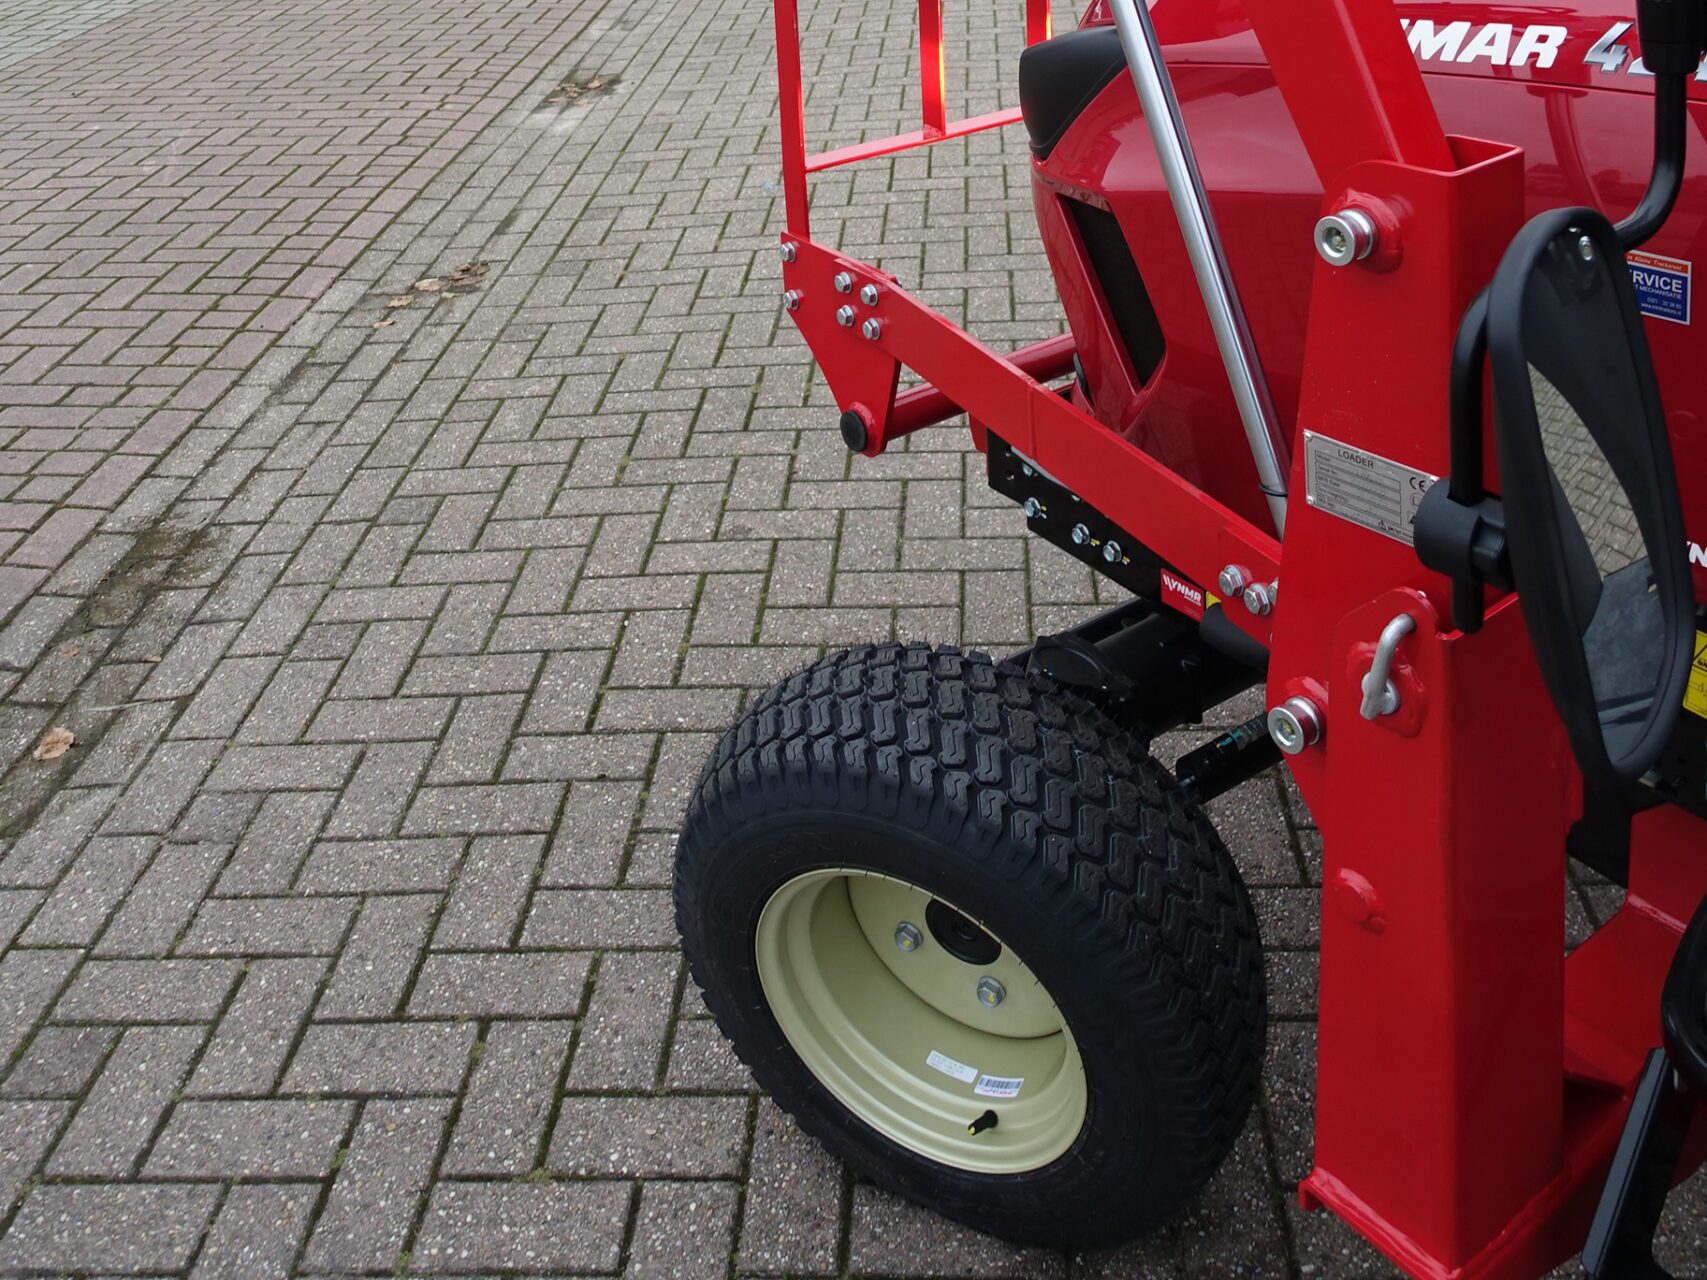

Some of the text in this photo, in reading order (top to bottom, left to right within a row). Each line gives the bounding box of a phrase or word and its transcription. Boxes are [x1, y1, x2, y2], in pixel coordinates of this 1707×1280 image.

[1631, 269, 1682, 293] RVICE
[1639, 286, 1682, 300] MECHANISATIE
[1337, 448, 1374, 469] LOADER
